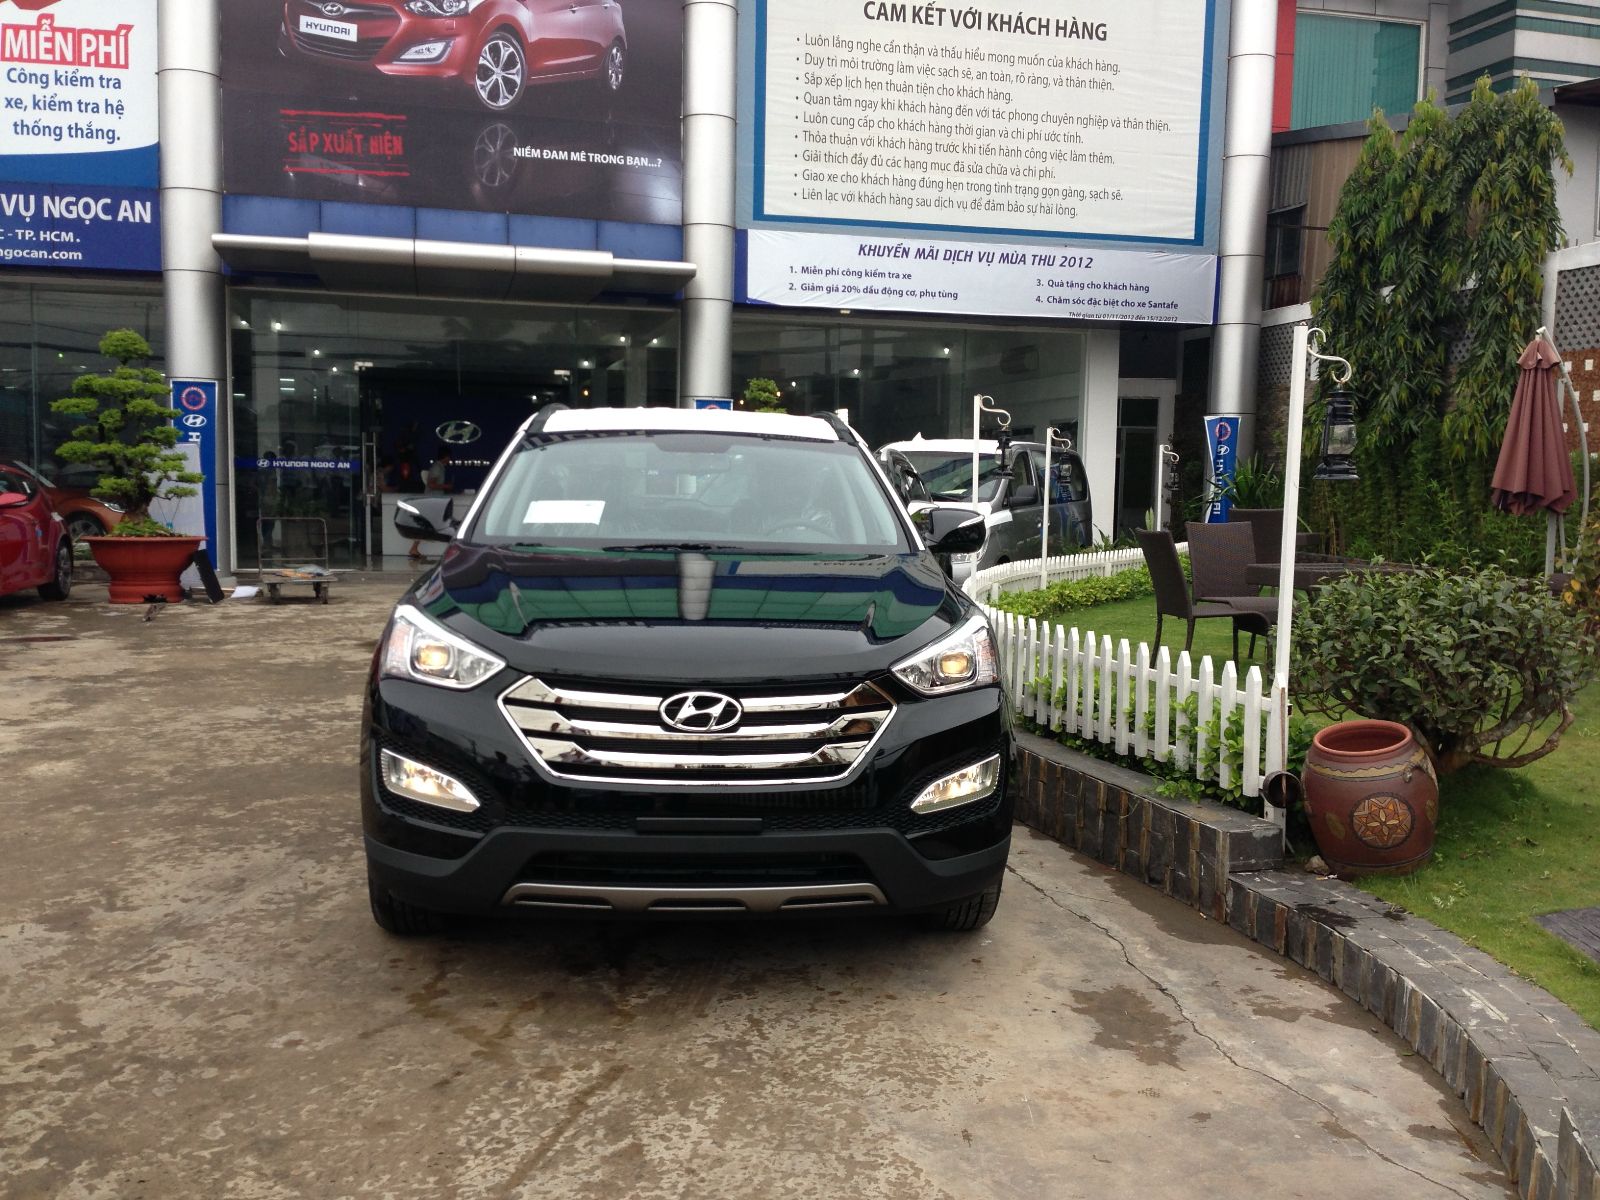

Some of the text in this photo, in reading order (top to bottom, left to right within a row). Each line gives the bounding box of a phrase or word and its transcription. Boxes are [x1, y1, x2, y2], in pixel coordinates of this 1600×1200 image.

[305, 21, 350, 35] HYUNDAI
[864, 1, 1107, 41] CAM KẾT VỚI KHÁCH HÀNG
[5, 18, 127, 65] MIỄN PHÍ
[805, 33, 830, 47] Luôn
[856, 38, 882, 54] nghe
[927, 45, 938, 57] và
[988, 53, 1015, 67] mong
[1047, 55, 1064, 68] của
[1065, 56, 1093, 70] khách
[1095, 59, 1120, 76] hàng.
[6, 67, 122, 90] Công kiểm tra
[845, 75, 862, 90] lịch
[916, 82, 934, 97] tiện
[936, 83, 955, 97] cho
[956, 85, 985, 99] khách
[987, 87, 1013, 105] hàng.
[4, 92, 125, 120] xe, kiểm tra hệ
[803, 91, 830, 106] Quan
[854, 99, 879, 112] ngay
[880, 98, 896, 110] khi
[898, 99, 926, 113] khách
[928, 102, 953, 119] hàng
[975, 106, 990, 118] với
[992, 108, 1006, 120] tác
[1008, 109, 1038, 125] phong
[1040, 111, 1074, 127] chuyên
[1076, 114, 1109, 130] nghiệp
[1110, 117, 1121, 128] và
[13, 118, 121, 145] thống thắng.
[803, 111, 828, 124] Luôn
[830, 116, 855, 130] cung
[857, 115, 875, 131] cấp
[877, 117, 895, 130] cho
[897, 118, 926, 132] khách
[928, 120, 952, 138] hàng
[954, 123, 974, 136] thời
[975, 125, 996, 140] gian
[998, 126, 1009, 138] và
[1010, 128, 1025, 140] chi
[1027, 128, 1042, 142] phí
[542, 150, 568, 160] ĐAM
[570, 150, 586, 162] MÊ
[588, 153, 624, 165] TRONG
[802, 149, 822, 162] Giải
[824, 150, 848, 164] thích
[870, 154, 884, 167] đủ
[885, 156, 902, 168] các
[1010, 165, 1021, 176] và
[1022, 165, 1036, 178] chi
[1038, 166, 1056, 180] phí.
[802, 168, 825, 182] Giao
[827, 173, 838, 182] xe
[840, 171, 859, 184] cho
[861, 172, 890, 186] khách
[892, 174, 917, 191] hàng
[918, 176, 944, 192] đúng
[966, 181, 992, 196] trong
[994, 181, 1012, 193] tình
[1014, 184, 1040, 199] trạng
[1041, 187, 1060, 199] gọn
[1061, 186, 1087, 202] gàng,
[1089, 188, 1109, 202] sạch
[0, 193, 151, 225] VỤ NGỌC AN
[15, 229, 36, 241] TP.
[942, 249, 973, 264] DỊCH
[978, 251, 995, 266] VỤ
[998, 250, 1027, 265] MÙA
[1031, 254, 1056, 266] THU
[1058, 256, 1094, 268] 2012
[789, 266, 798, 274] 1.
[825, 267, 840, 277] phí
[887, 271, 900, 279] tra
[1036, 278, 1044, 287] 3.
[1086, 281, 1102, 289] cho
[1102, 282, 1128, 291] khách
[1129, 283, 1150, 294] hàng
[788, 282, 797, 291] 2.
[825, 284, 840, 294] giá
[841, 285, 861, 294] 20%
[919, 289, 936, 299] phụ
[938, 290, 958, 301] tùng
[1035, 295, 1044, 303] 4.
[1072, 297, 1086, 305] sóc
[1103, 298, 1120, 308] biệt
[1120, 299, 1136, 307] cho
[1148, 300, 1178, 309] Santafe
[273, 460, 308, 468] HYUNDAI
